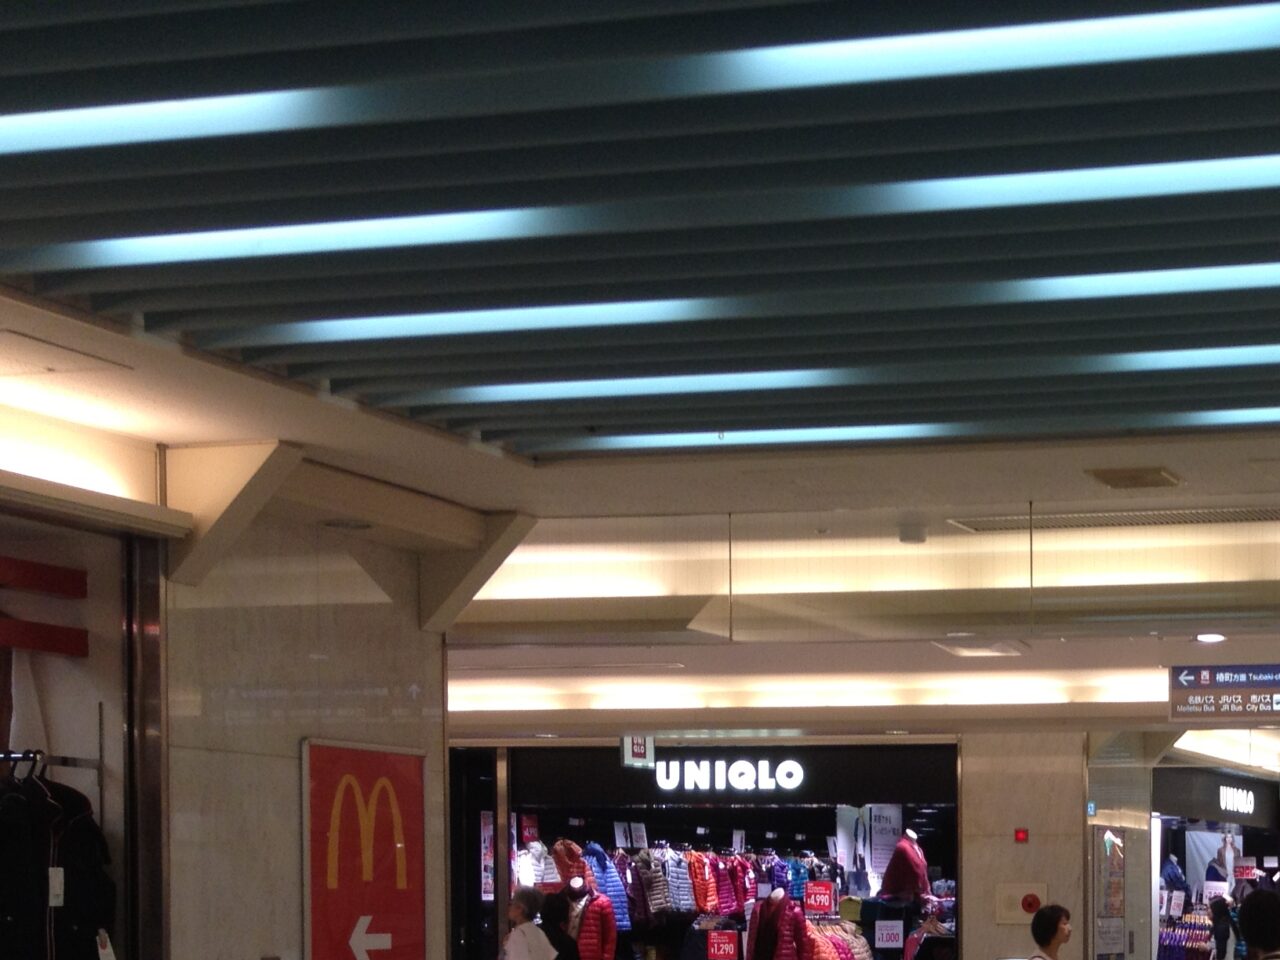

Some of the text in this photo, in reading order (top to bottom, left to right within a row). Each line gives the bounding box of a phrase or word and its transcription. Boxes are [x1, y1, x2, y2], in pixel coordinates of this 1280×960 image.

[1219, 695, 1242, 704] JRバス
[1220, 703, 1242, 712] JR Bus
[1246, 703, 1271, 712] City Bus
[633, 745, 645, 753] QLO
[656, 760, 804, 790] UNIQLO
[1219, 785, 1255, 814] UNIQLO
